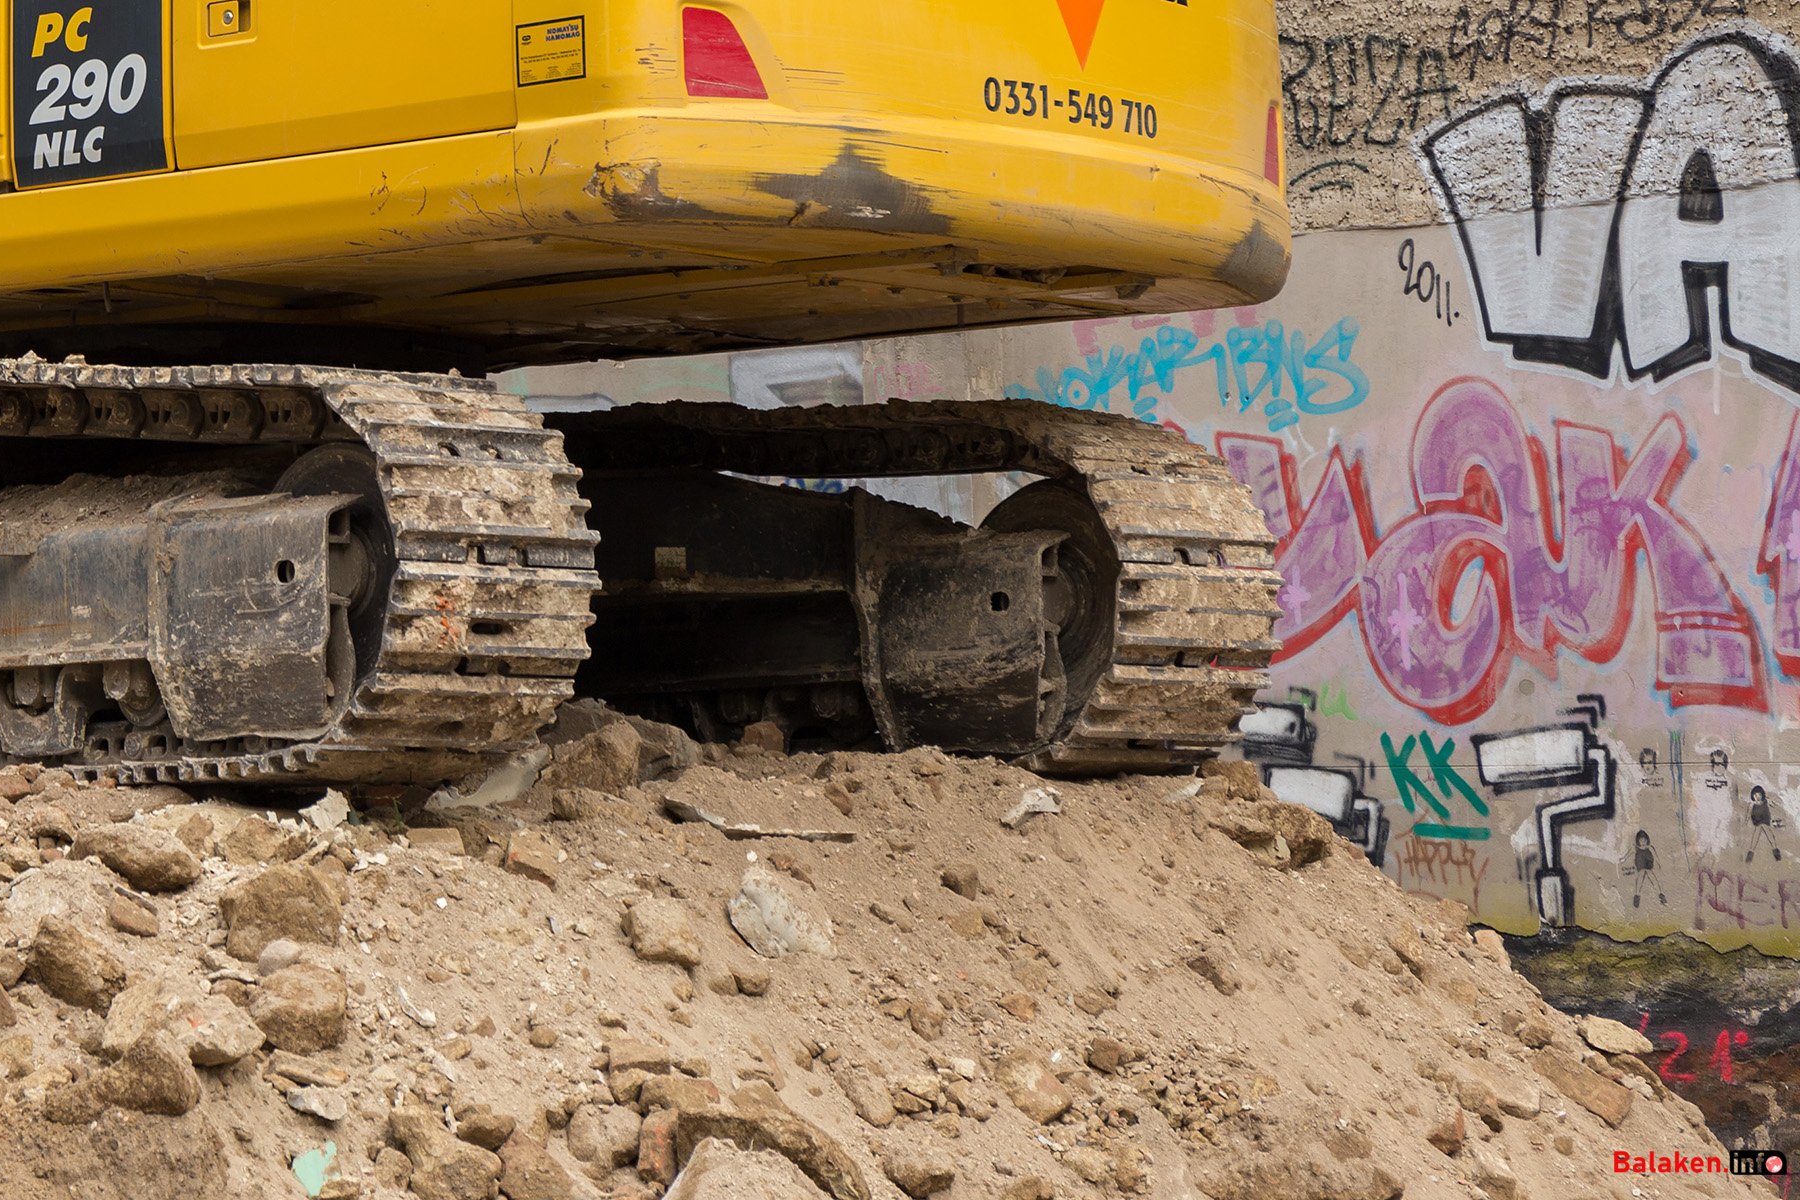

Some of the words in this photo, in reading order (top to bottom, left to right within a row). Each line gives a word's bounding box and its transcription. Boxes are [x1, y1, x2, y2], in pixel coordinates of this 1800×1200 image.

[31, 6, 93, 58] PC
[29, 53, 147, 125] 290
[983, 76, 1114, 131] 0331-549
[1122, 98, 1158, 140] 710
[32, 125, 104, 170] NLC
[1381, 730, 1490, 820] KK
